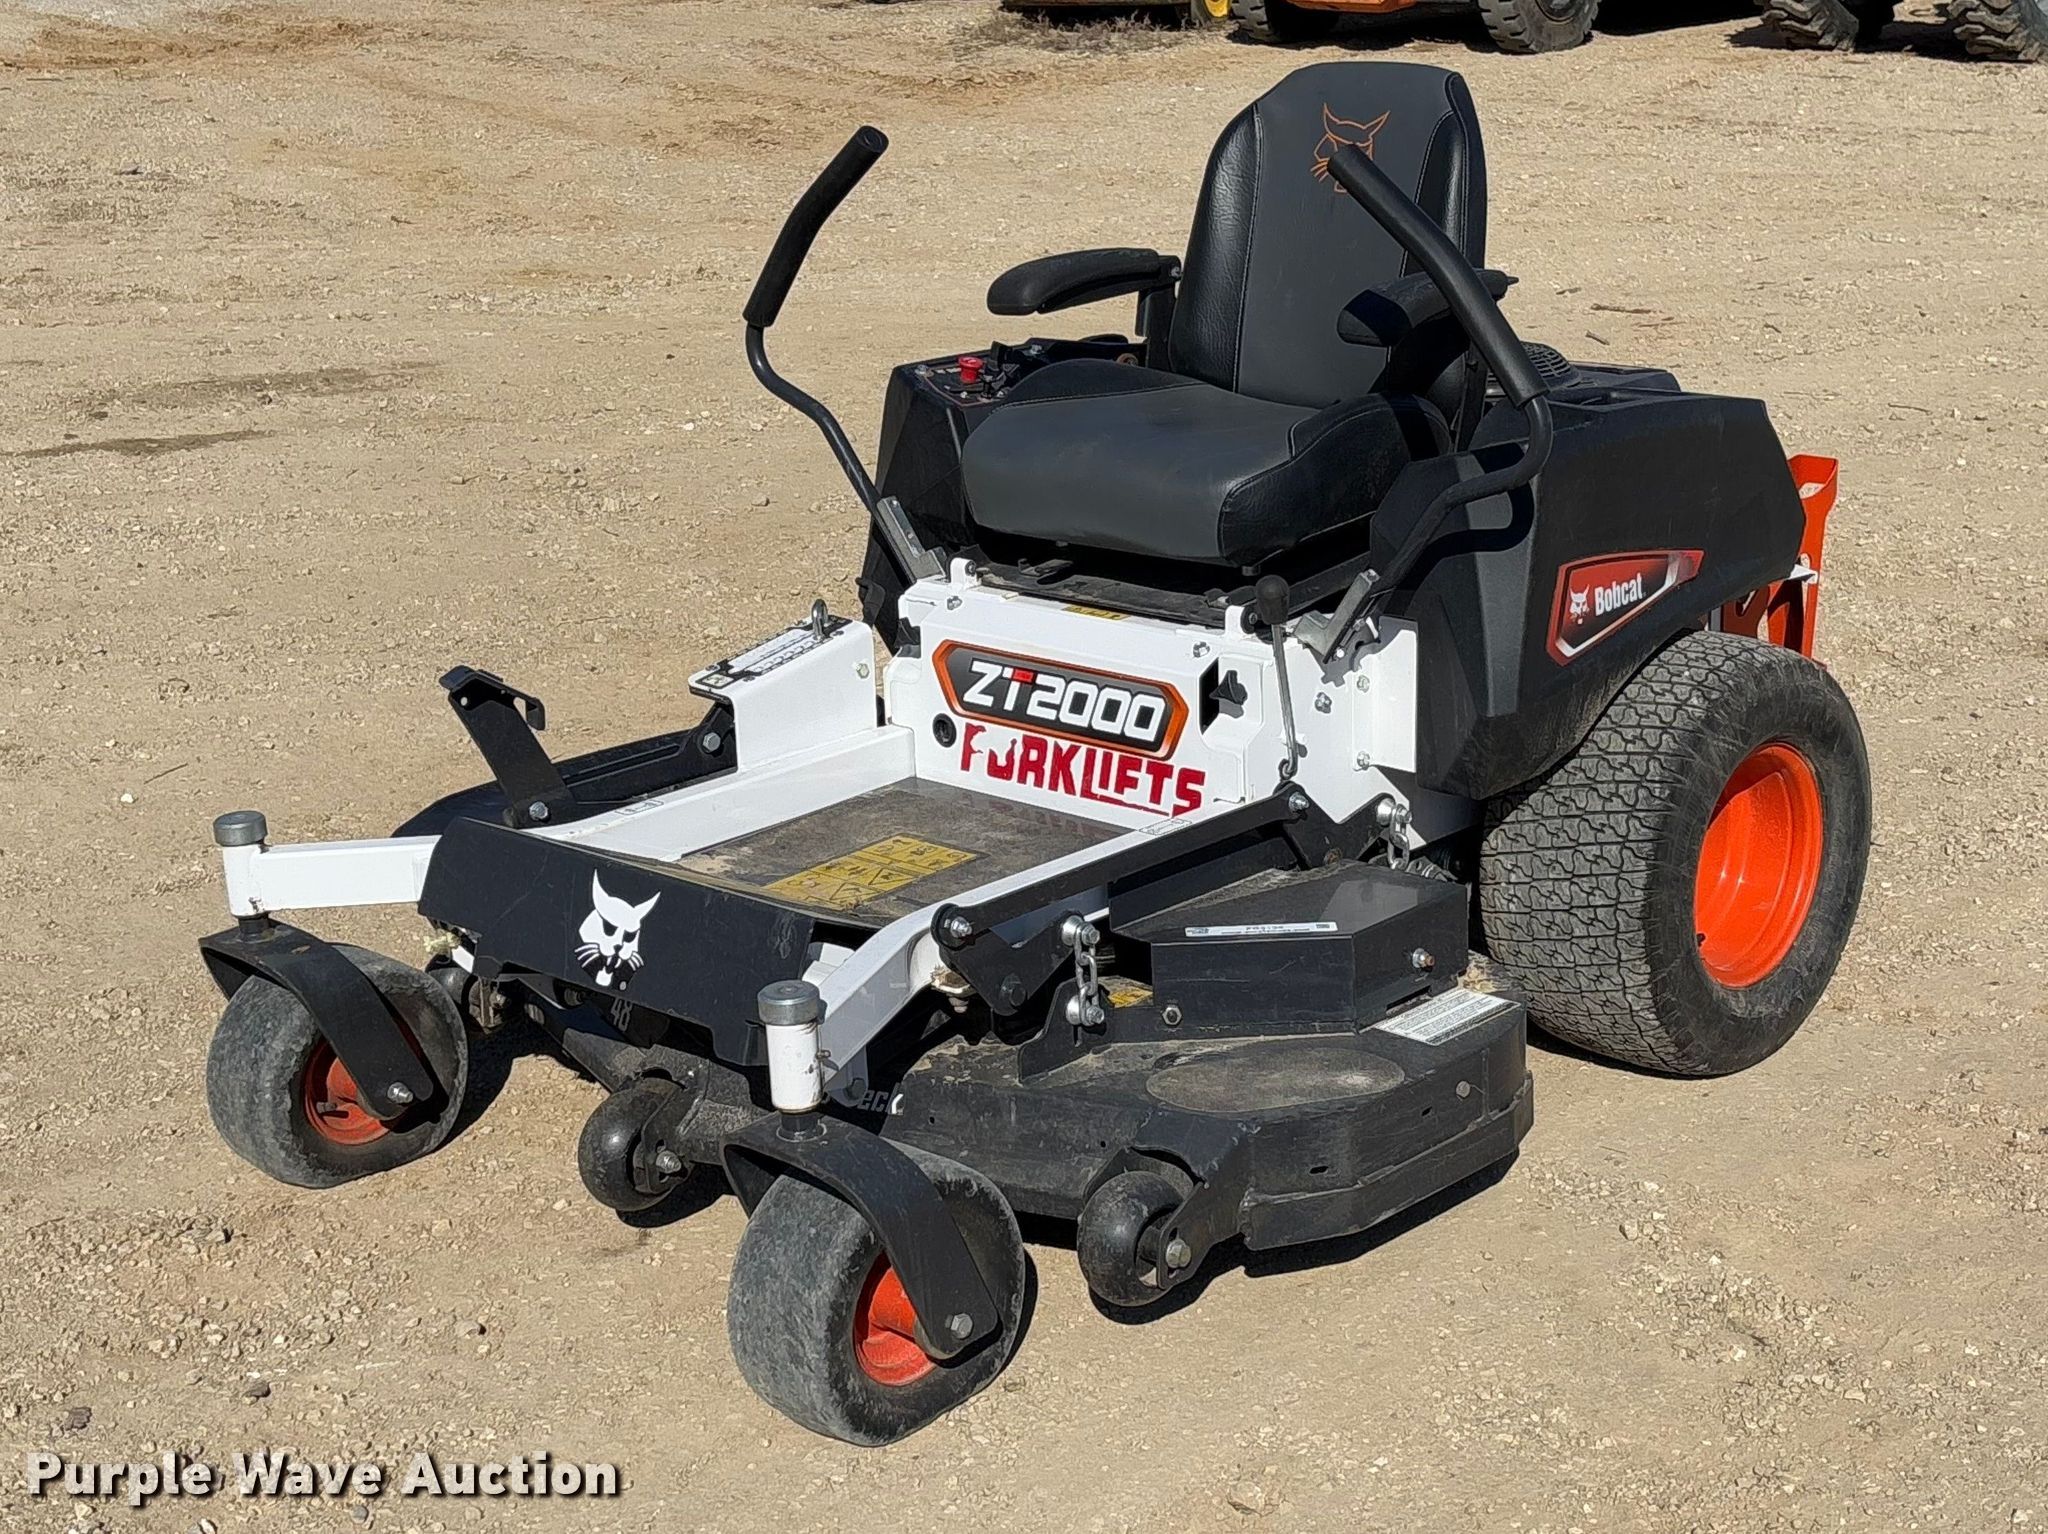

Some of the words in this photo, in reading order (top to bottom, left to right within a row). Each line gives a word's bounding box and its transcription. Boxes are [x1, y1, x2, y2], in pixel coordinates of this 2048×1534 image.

[1594, 572, 1643, 617] Bobcat
[963, 659, 1167, 742] ZT2000
[960, 722, 1206, 819] FORKLIFTS
